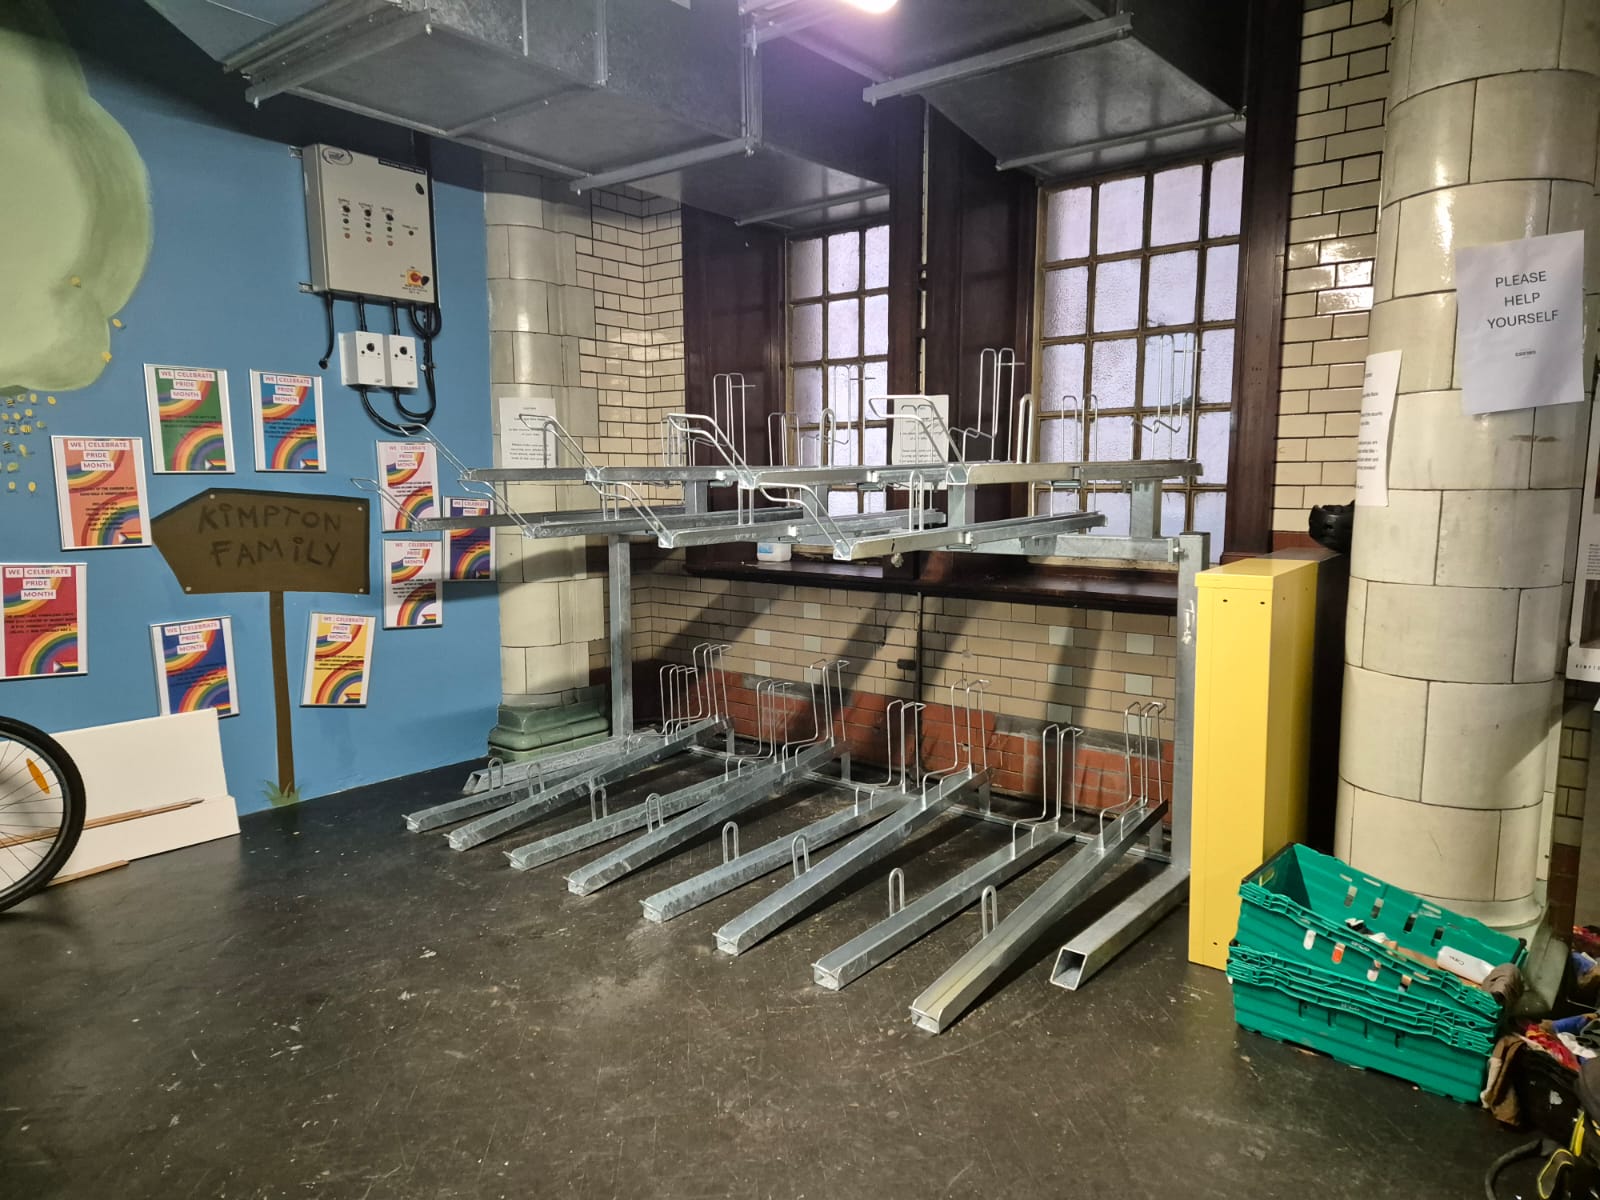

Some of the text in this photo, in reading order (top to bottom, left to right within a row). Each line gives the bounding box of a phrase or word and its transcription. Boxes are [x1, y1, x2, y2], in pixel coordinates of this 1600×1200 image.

[1495, 271, 1547, 288] PLEASE
[1504, 292, 1541, 307] HELP
[1487, 310, 1560, 329] YOURSELF
[176, 372, 213, 380] CELEBRATE
[172, 391, 200, 399] MONTH
[182, 623, 218, 632] CELEBRATE
[180, 634, 201, 642] PRIDE
[178, 644, 205, 652] MONTH
